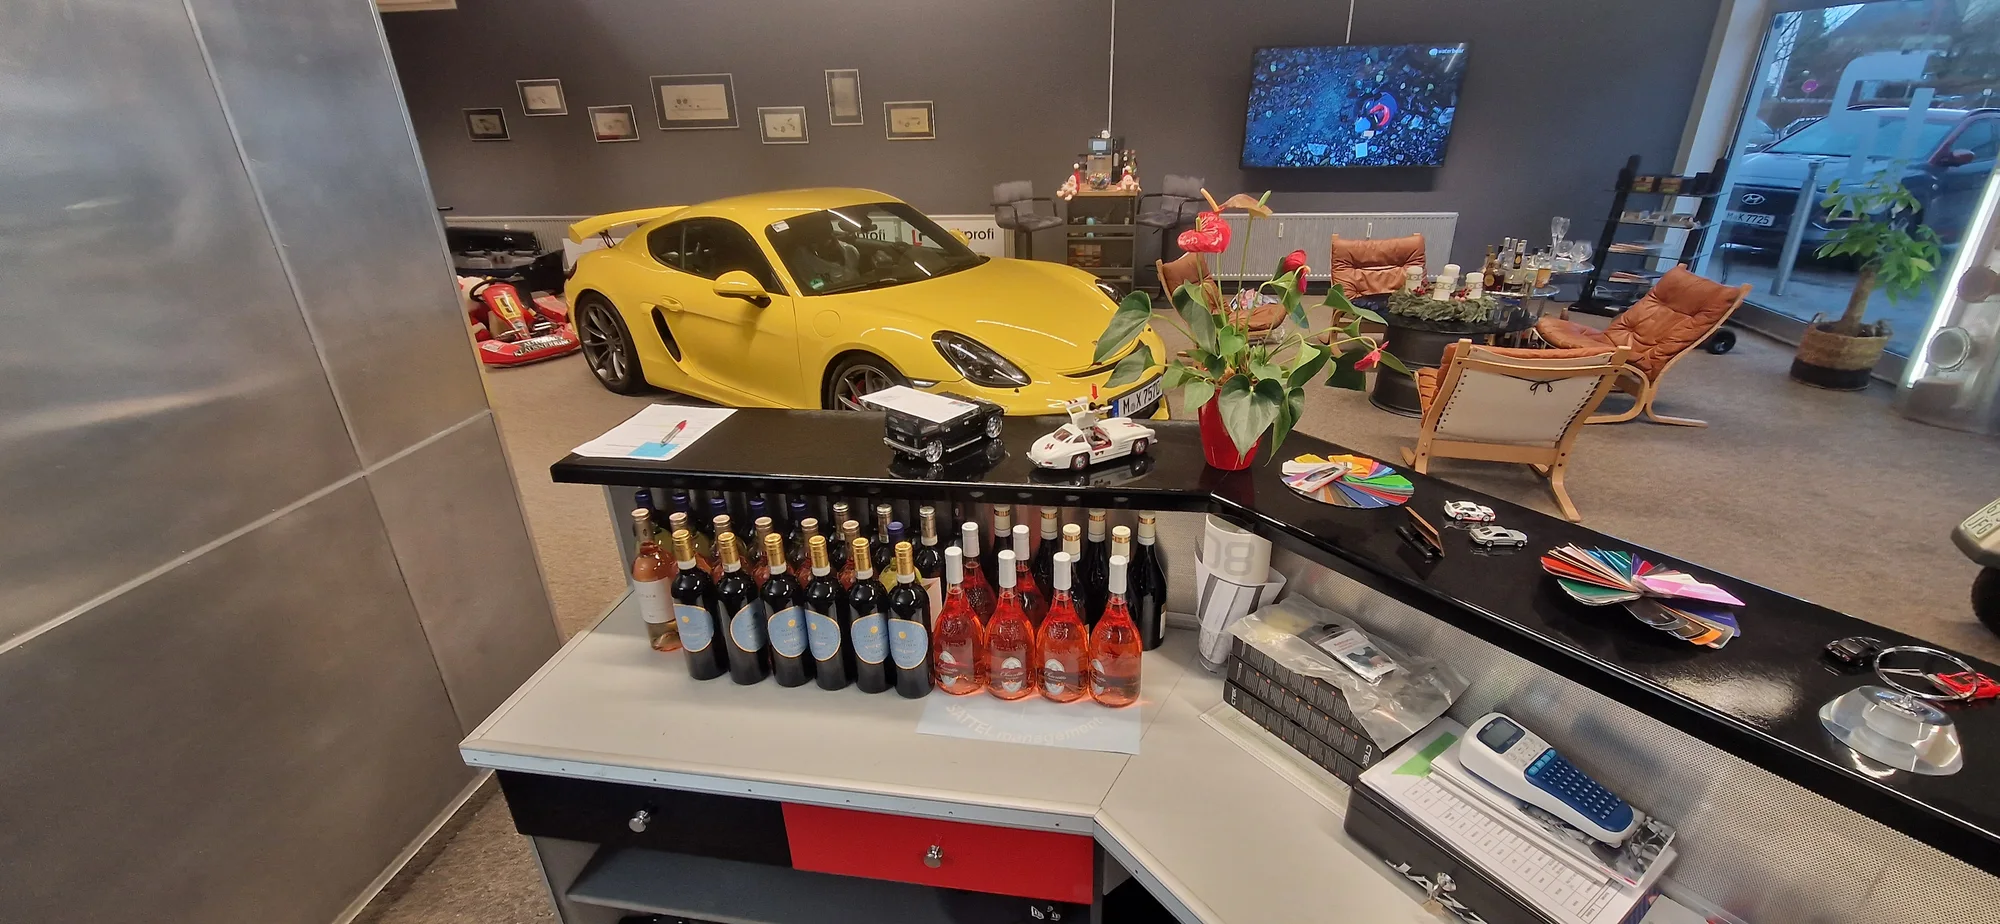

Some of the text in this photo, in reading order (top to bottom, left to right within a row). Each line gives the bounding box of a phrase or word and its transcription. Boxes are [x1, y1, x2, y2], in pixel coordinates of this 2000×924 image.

[1746, 214, 1770, 225] 7725
[959, 227, 995, 240] profi
[1122, 400, 1130, 414] M
[1135, 392, 1142, 409] X
[998, 716, 1103, 744] management
[1361, 744, 1373, 767] CTEK
